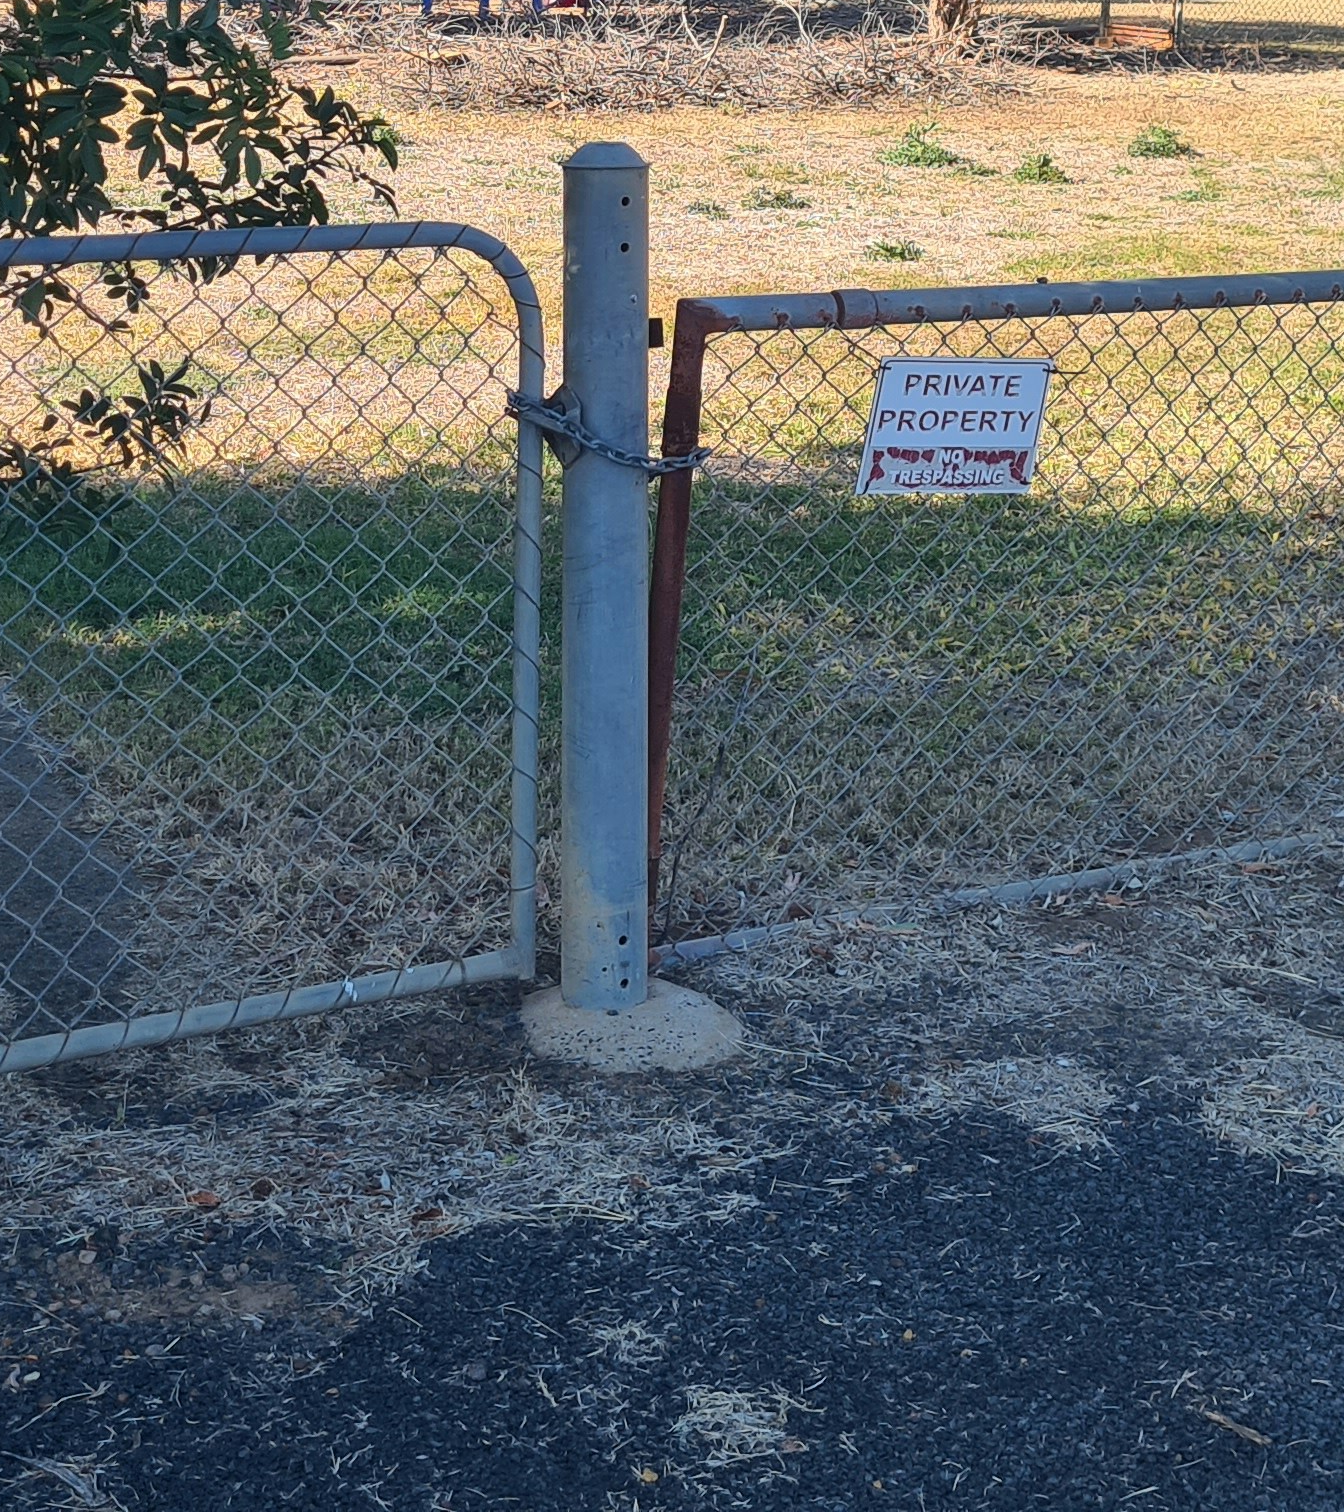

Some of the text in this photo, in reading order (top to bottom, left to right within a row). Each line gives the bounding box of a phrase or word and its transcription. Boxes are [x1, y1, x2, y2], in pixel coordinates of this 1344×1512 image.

[904, 374, 1023, 397] PRIVATE
[876, 409, 1035, 433] PROPERTY
[938, 448, 966, 465] NO
[888, 468, 1005, 486] TRESPASSING
